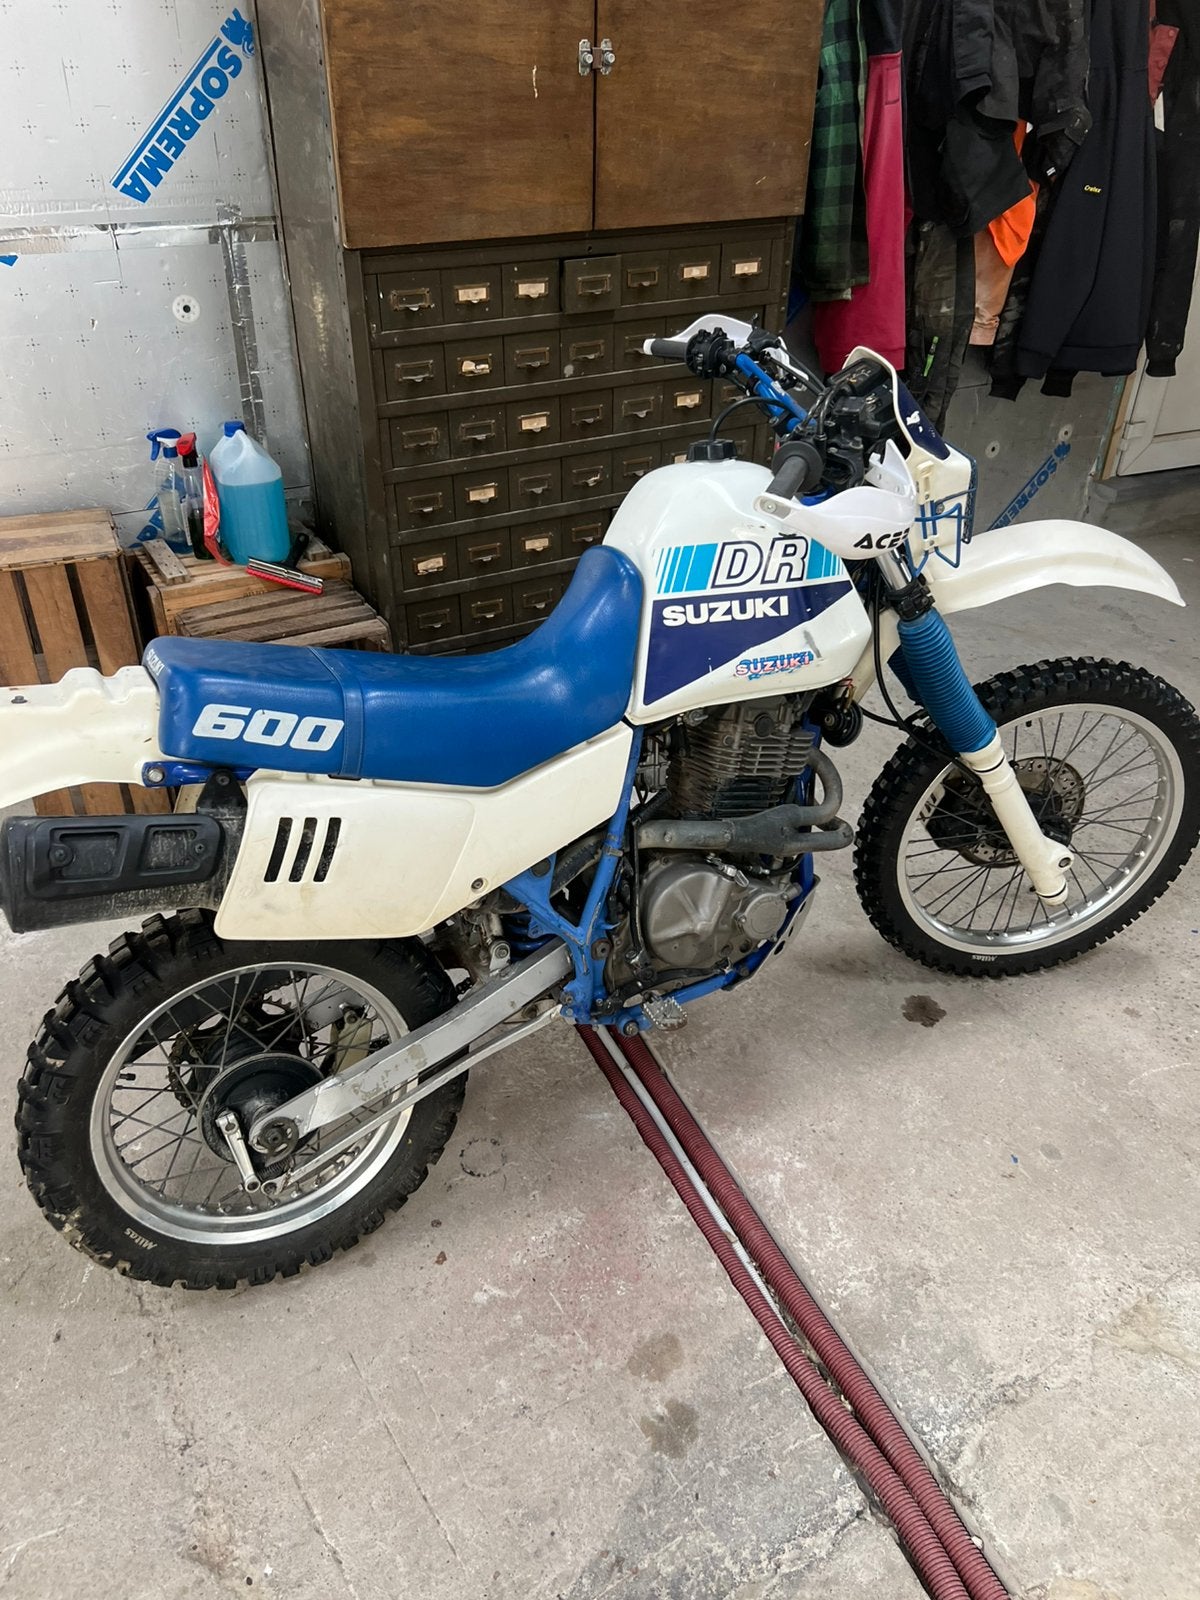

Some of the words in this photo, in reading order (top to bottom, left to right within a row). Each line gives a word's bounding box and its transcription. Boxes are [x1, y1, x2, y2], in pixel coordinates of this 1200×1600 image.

[119, 45, 243, 204] SOPREMA
[990, 459, 1058, 531] SOPREM
[710, 536, 809, 589] DR
[662, 595, 789, 627] SUZUKI
[735, 651, 814, 675] SUZUKI
[192, 703, 345, 751] 600
[124, 1227, 158, 1250] Mitas
